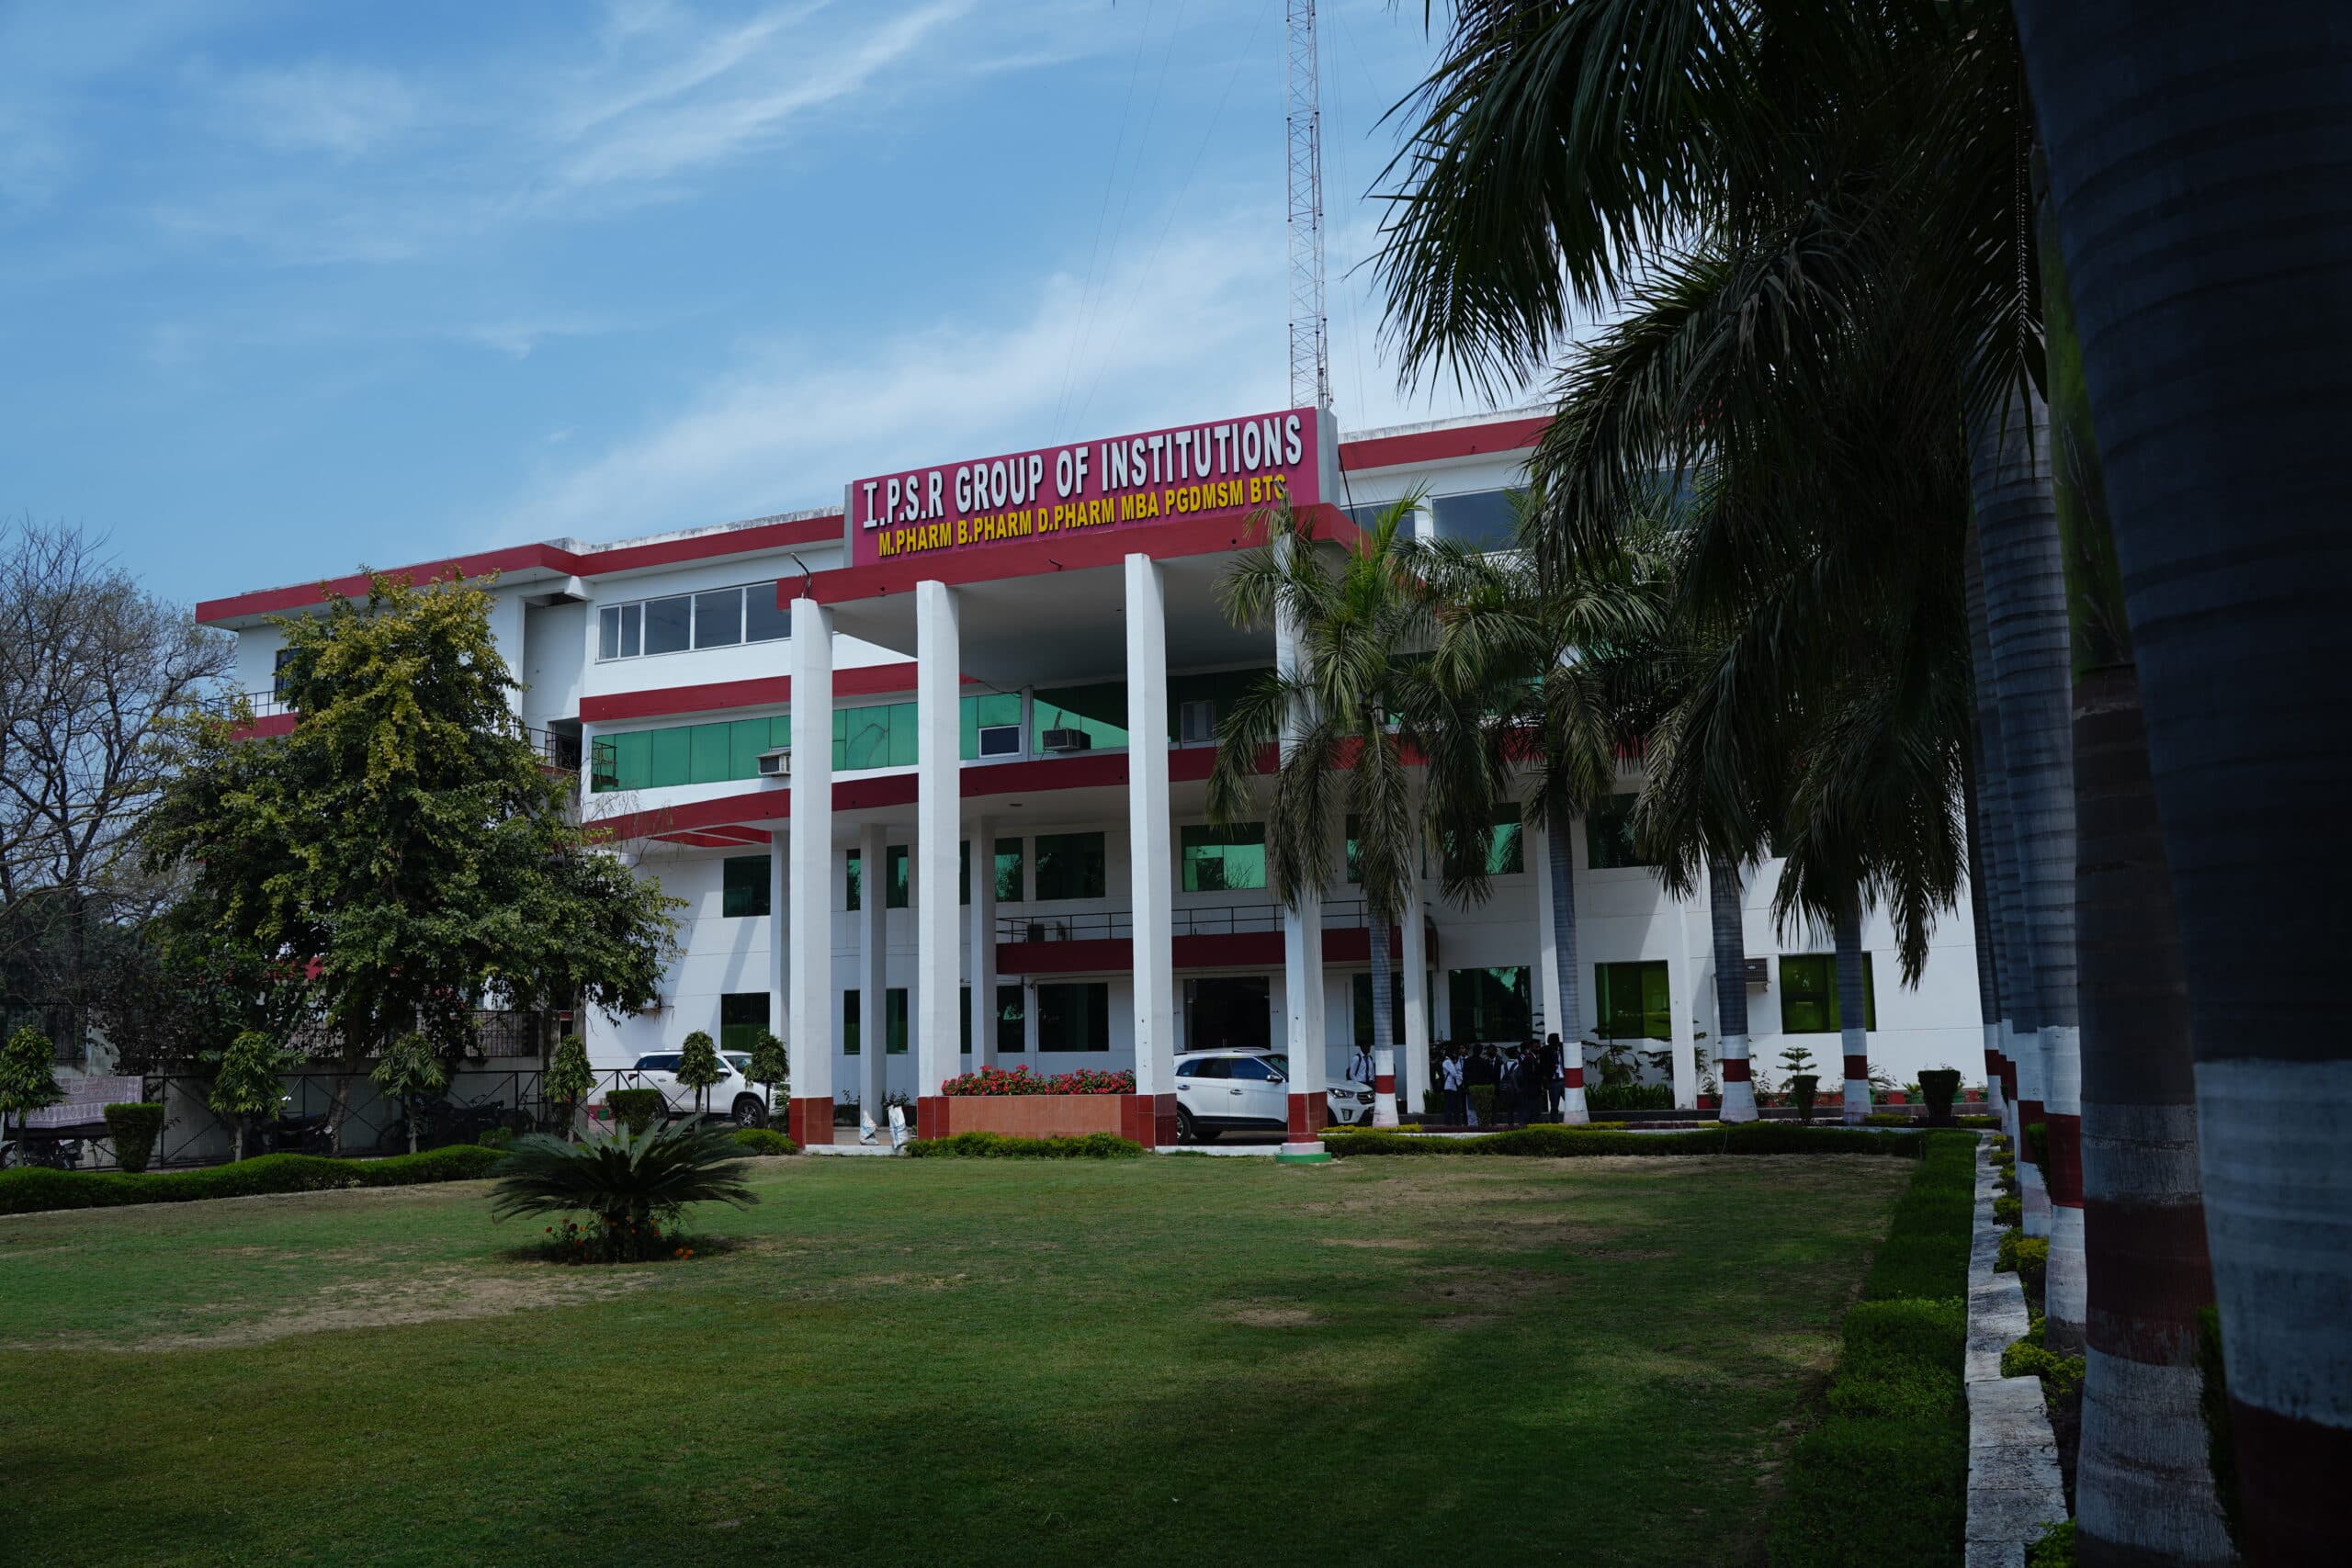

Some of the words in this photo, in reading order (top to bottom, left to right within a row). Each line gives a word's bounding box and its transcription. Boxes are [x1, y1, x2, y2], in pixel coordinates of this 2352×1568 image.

[863, 470, 944, 530] I.P.S.R
[956, 454, 1044, 513] GROUP
[1056, 446, 1090, 498] OF
[1102, 414, 1303, 491] INSTITUTIONS
[878, 521, 953, 558] M.PHARM
[957, 509, 1033, 546] B.PHARM
[1037, 496, 1115, 533] D.PHARM
[1121, 491, 1160, 522] MBA
[1165, 479, 1244, 516] PGDMSM
